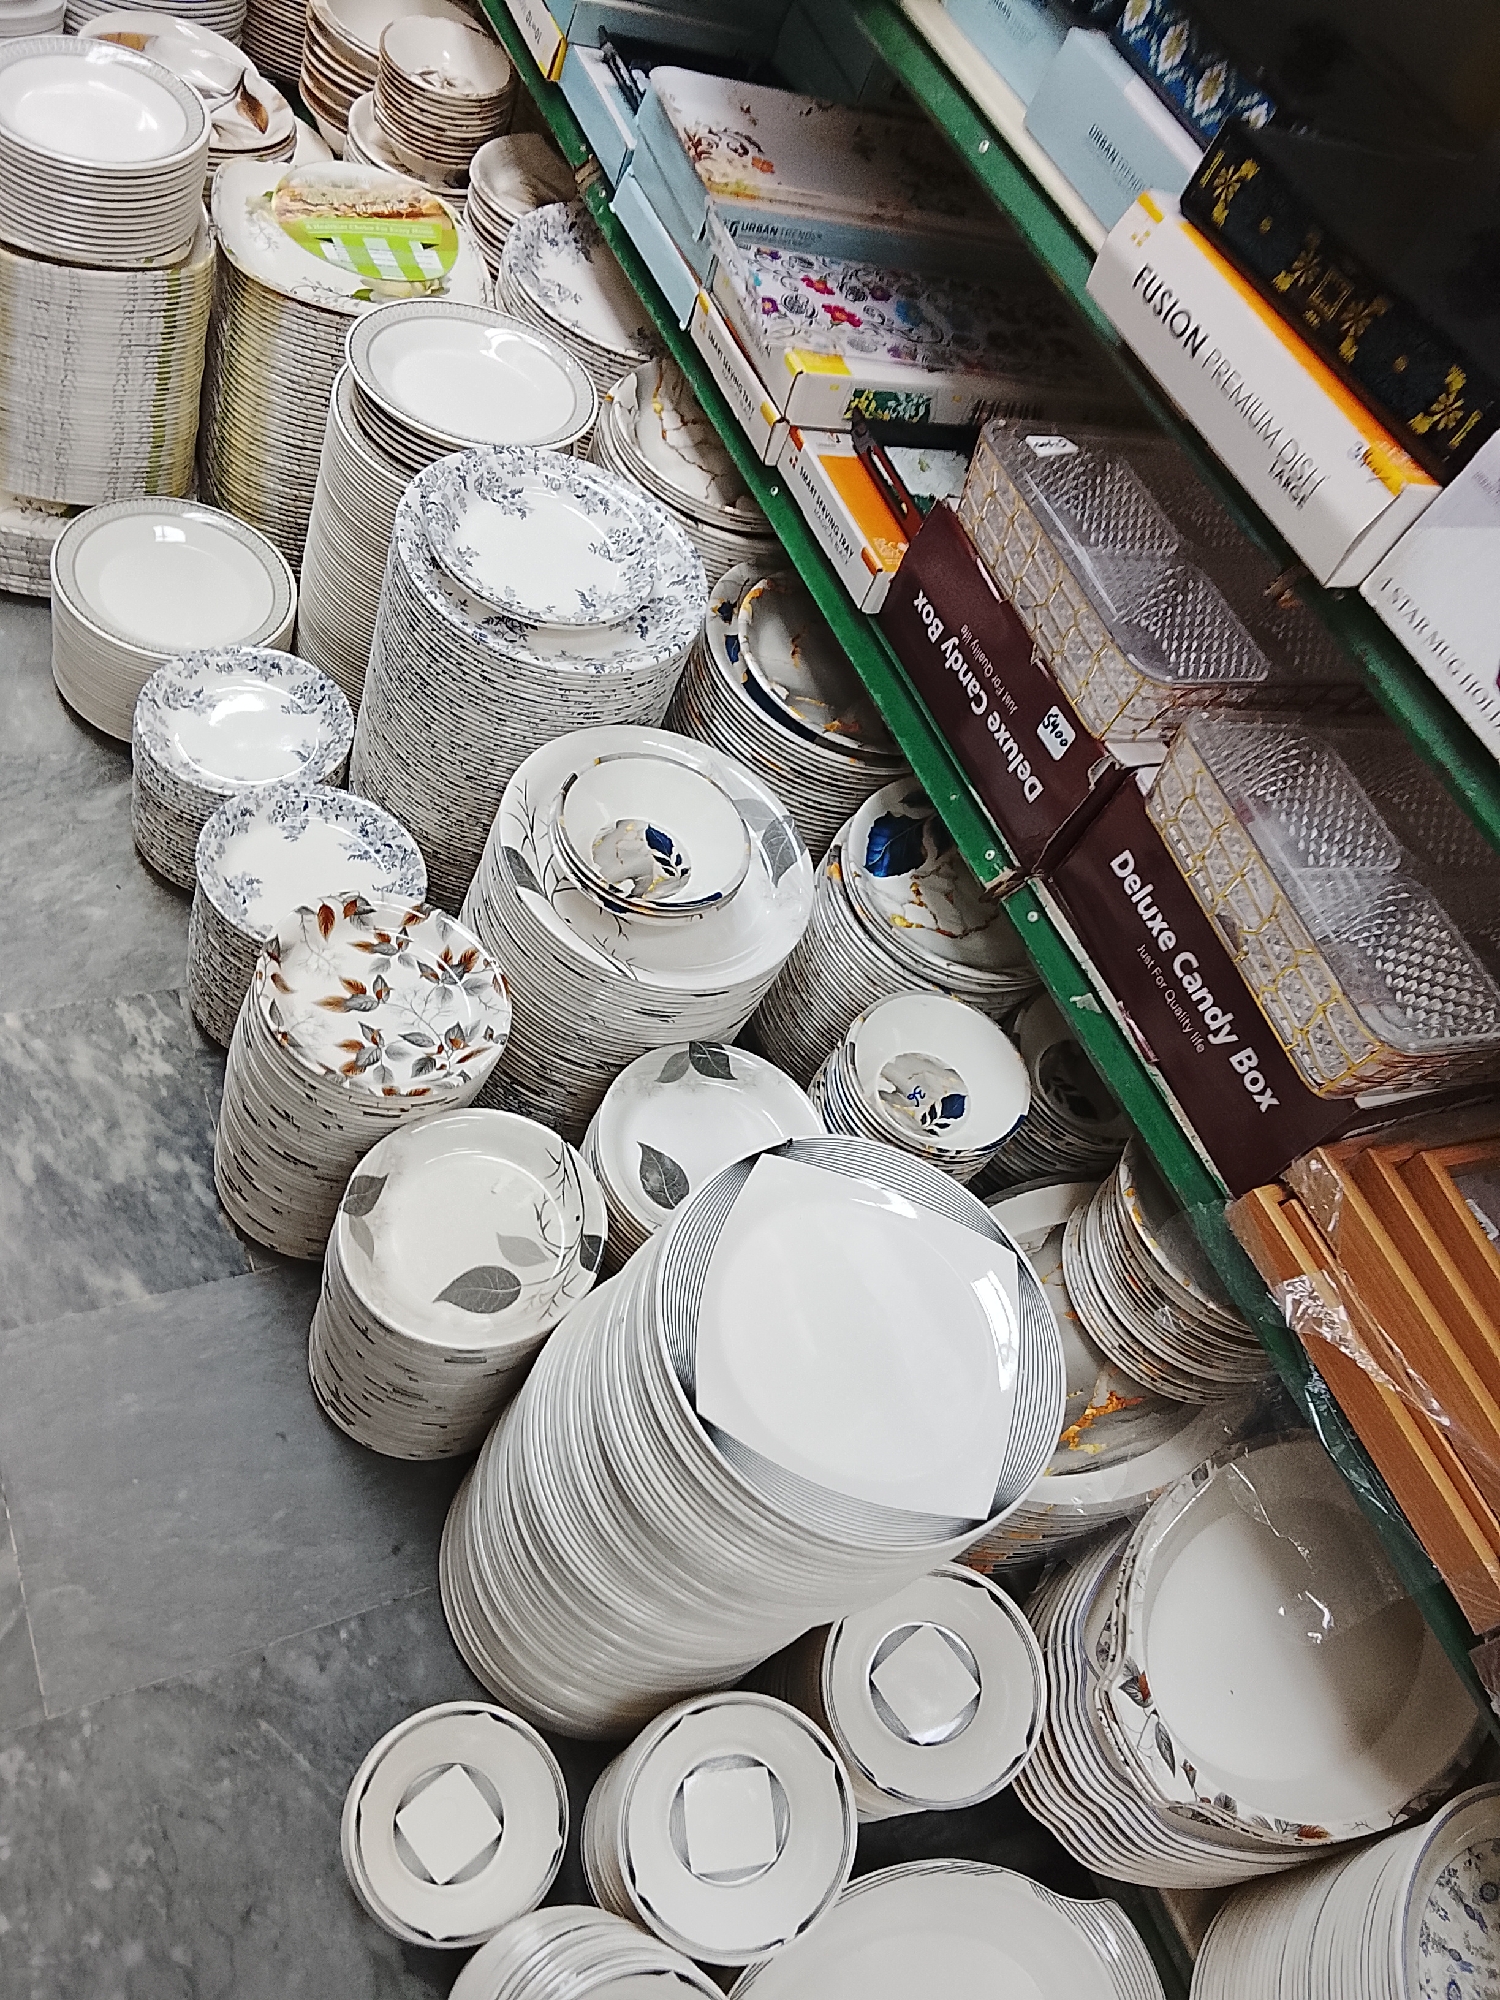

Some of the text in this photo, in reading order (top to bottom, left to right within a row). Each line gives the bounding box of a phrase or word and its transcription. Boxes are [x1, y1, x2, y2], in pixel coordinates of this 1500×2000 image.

[1087, 123, 1119, 163] URBAN
[740, 220, 778, 235] URBAN
[1133, 264, 1330, 497] FUSION PREMIUM DISH
[800, 466, 854, 557] SMART SERVING TRAY
[968, 638, 994, 677] Quality
[1391, 587, 1429, 635] STAR
[1425, 631, 1464, 676] MUG
[913, 589, 1044, 803] Deluxe Candy Box
[992, 675, 1005, 695] For
[1001, 691, 1018, 714] Just
[1110, 850, 1279, 1112] Deluxe Candy Box
[1137, 945, 1205, 1054] Just For Quality life
